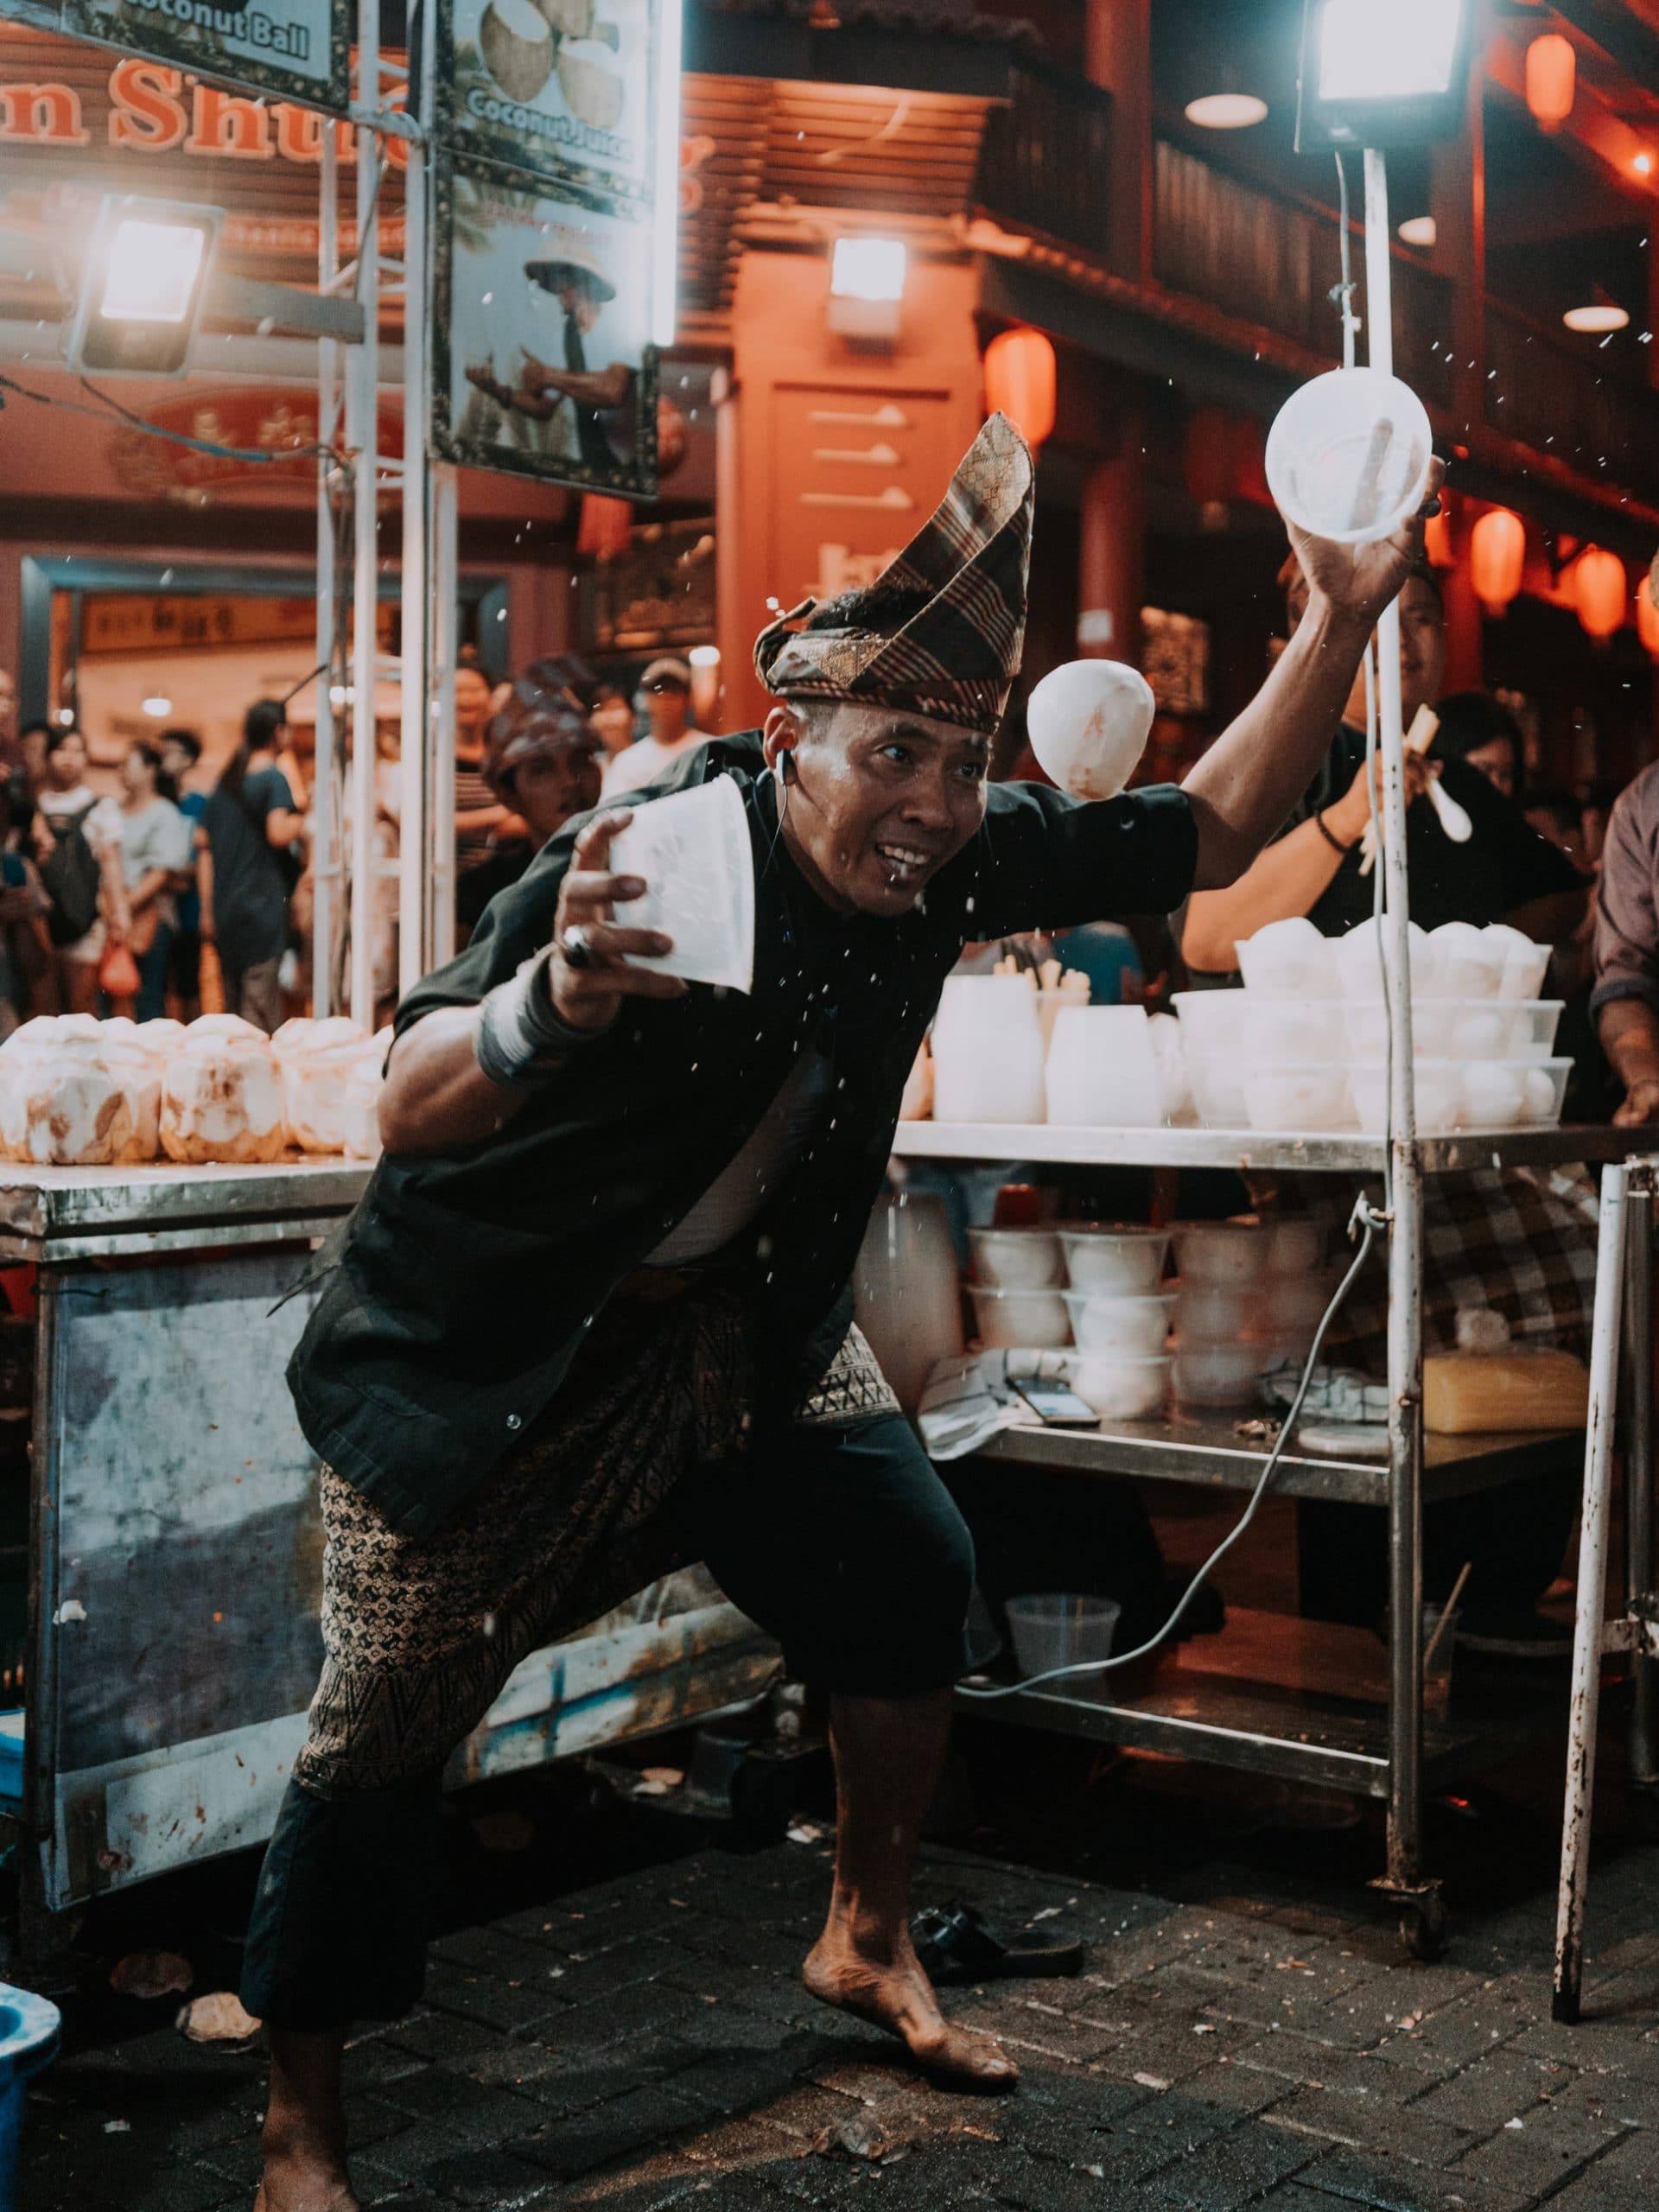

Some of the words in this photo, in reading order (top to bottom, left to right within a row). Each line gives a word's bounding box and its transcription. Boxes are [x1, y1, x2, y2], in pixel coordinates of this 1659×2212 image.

[124, 0, 248, 41] conut
[250, 11, 309, 60] Ball
[467, 90, 573, 146] Coconut
